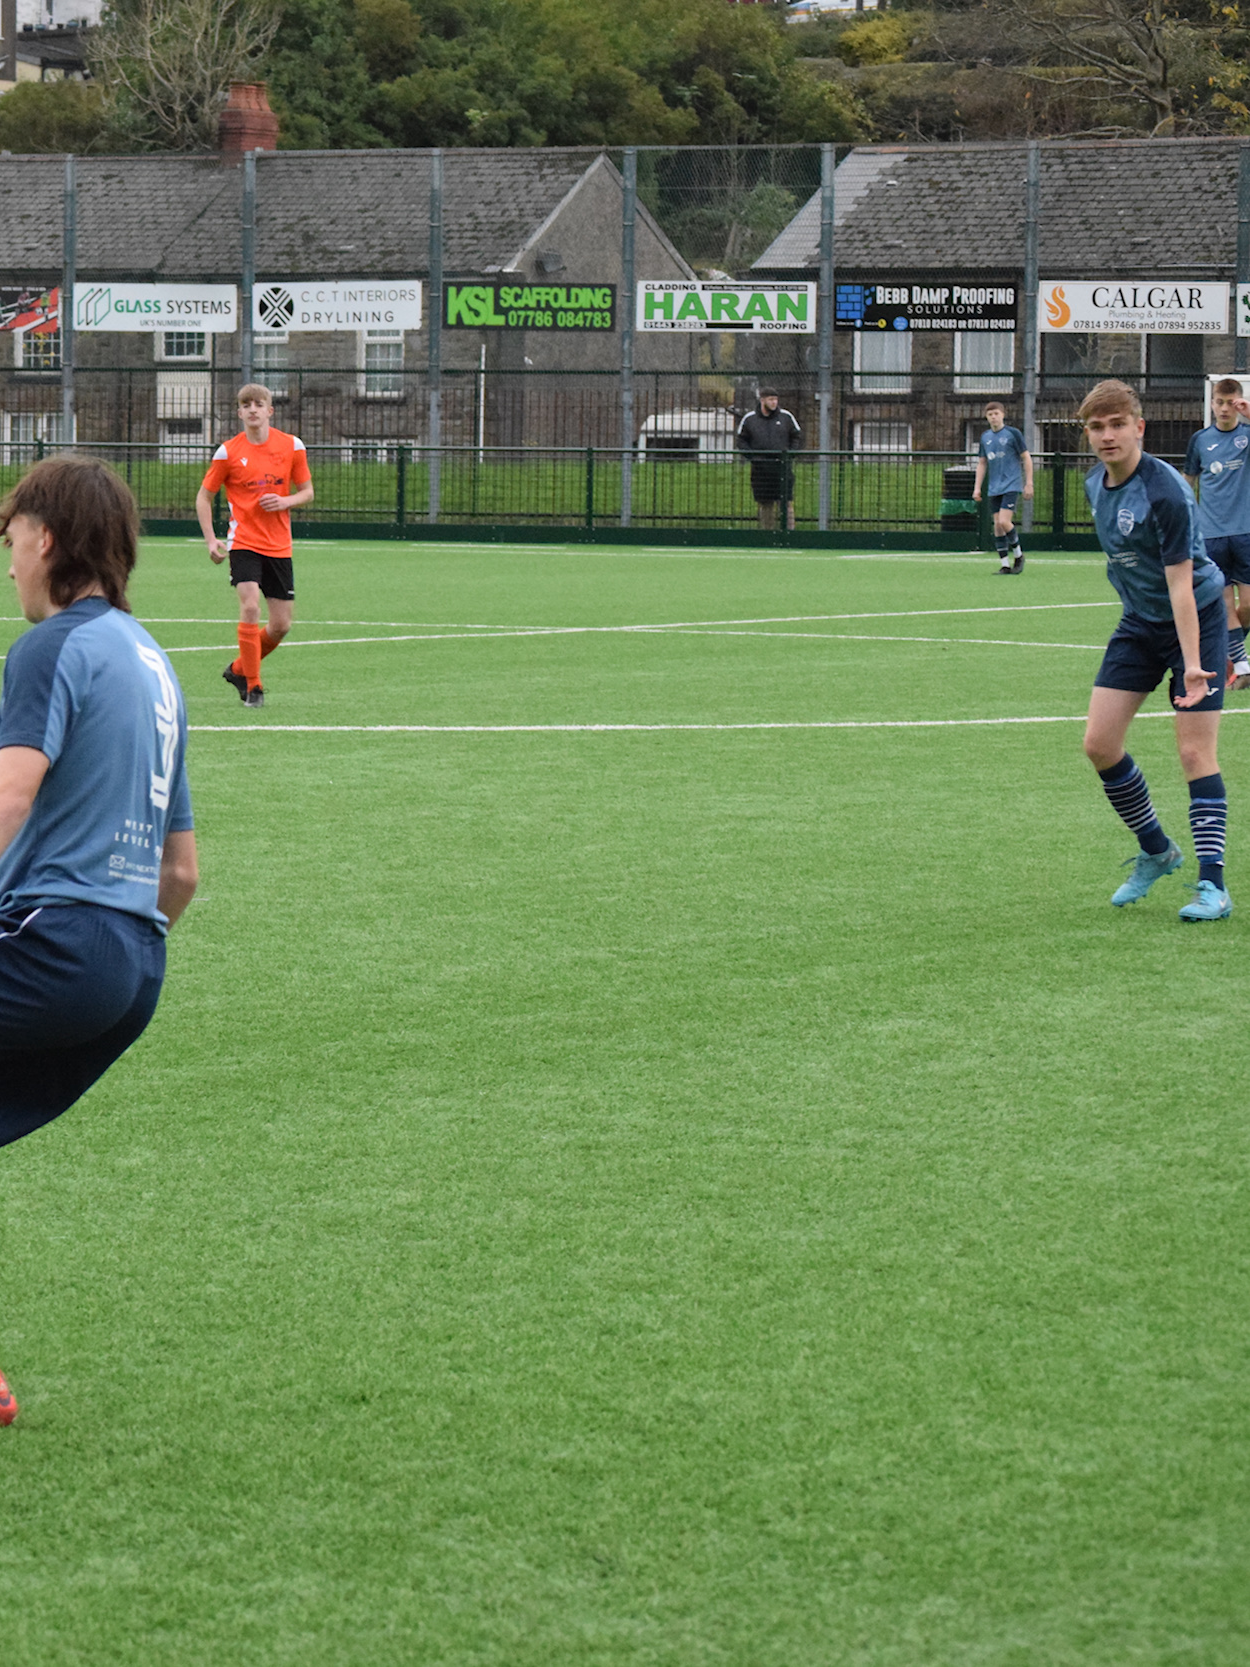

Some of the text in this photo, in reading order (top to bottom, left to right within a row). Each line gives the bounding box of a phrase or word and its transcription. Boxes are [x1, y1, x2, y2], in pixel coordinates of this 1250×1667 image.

[645, 283, 697, 291] CLADDING
[343, 289, 417, 302] INTERIORS
[912, 286, 950, 305] DAMP
[953, 286, 1015, 305] PROOFING
[1092, 287, 1204, 309] CALGAR
[114, 299, 232, 315] GLASS SYSTEMS
[447, 286, 612, 326] KSL SCAFFOLDING
[644, 292, 808, 321] HARAN
[907, 305, 984, 314] SOLUTIONS
[301, 310, 395, 324] DRYLINING
[507, 310, 612, 328] 07786 084783
[1108, 310, 1186, 320] Plumbing & Heating
[157, 319, 186, 327] NUMBER
[187, 319, 202, 327] ONE
[760, 322, 808, 330] ROOFING
[1073, 320, 1221, 330] 07814 937466 and 07894 952835
[114, 831, 150, 849] LEVEL
